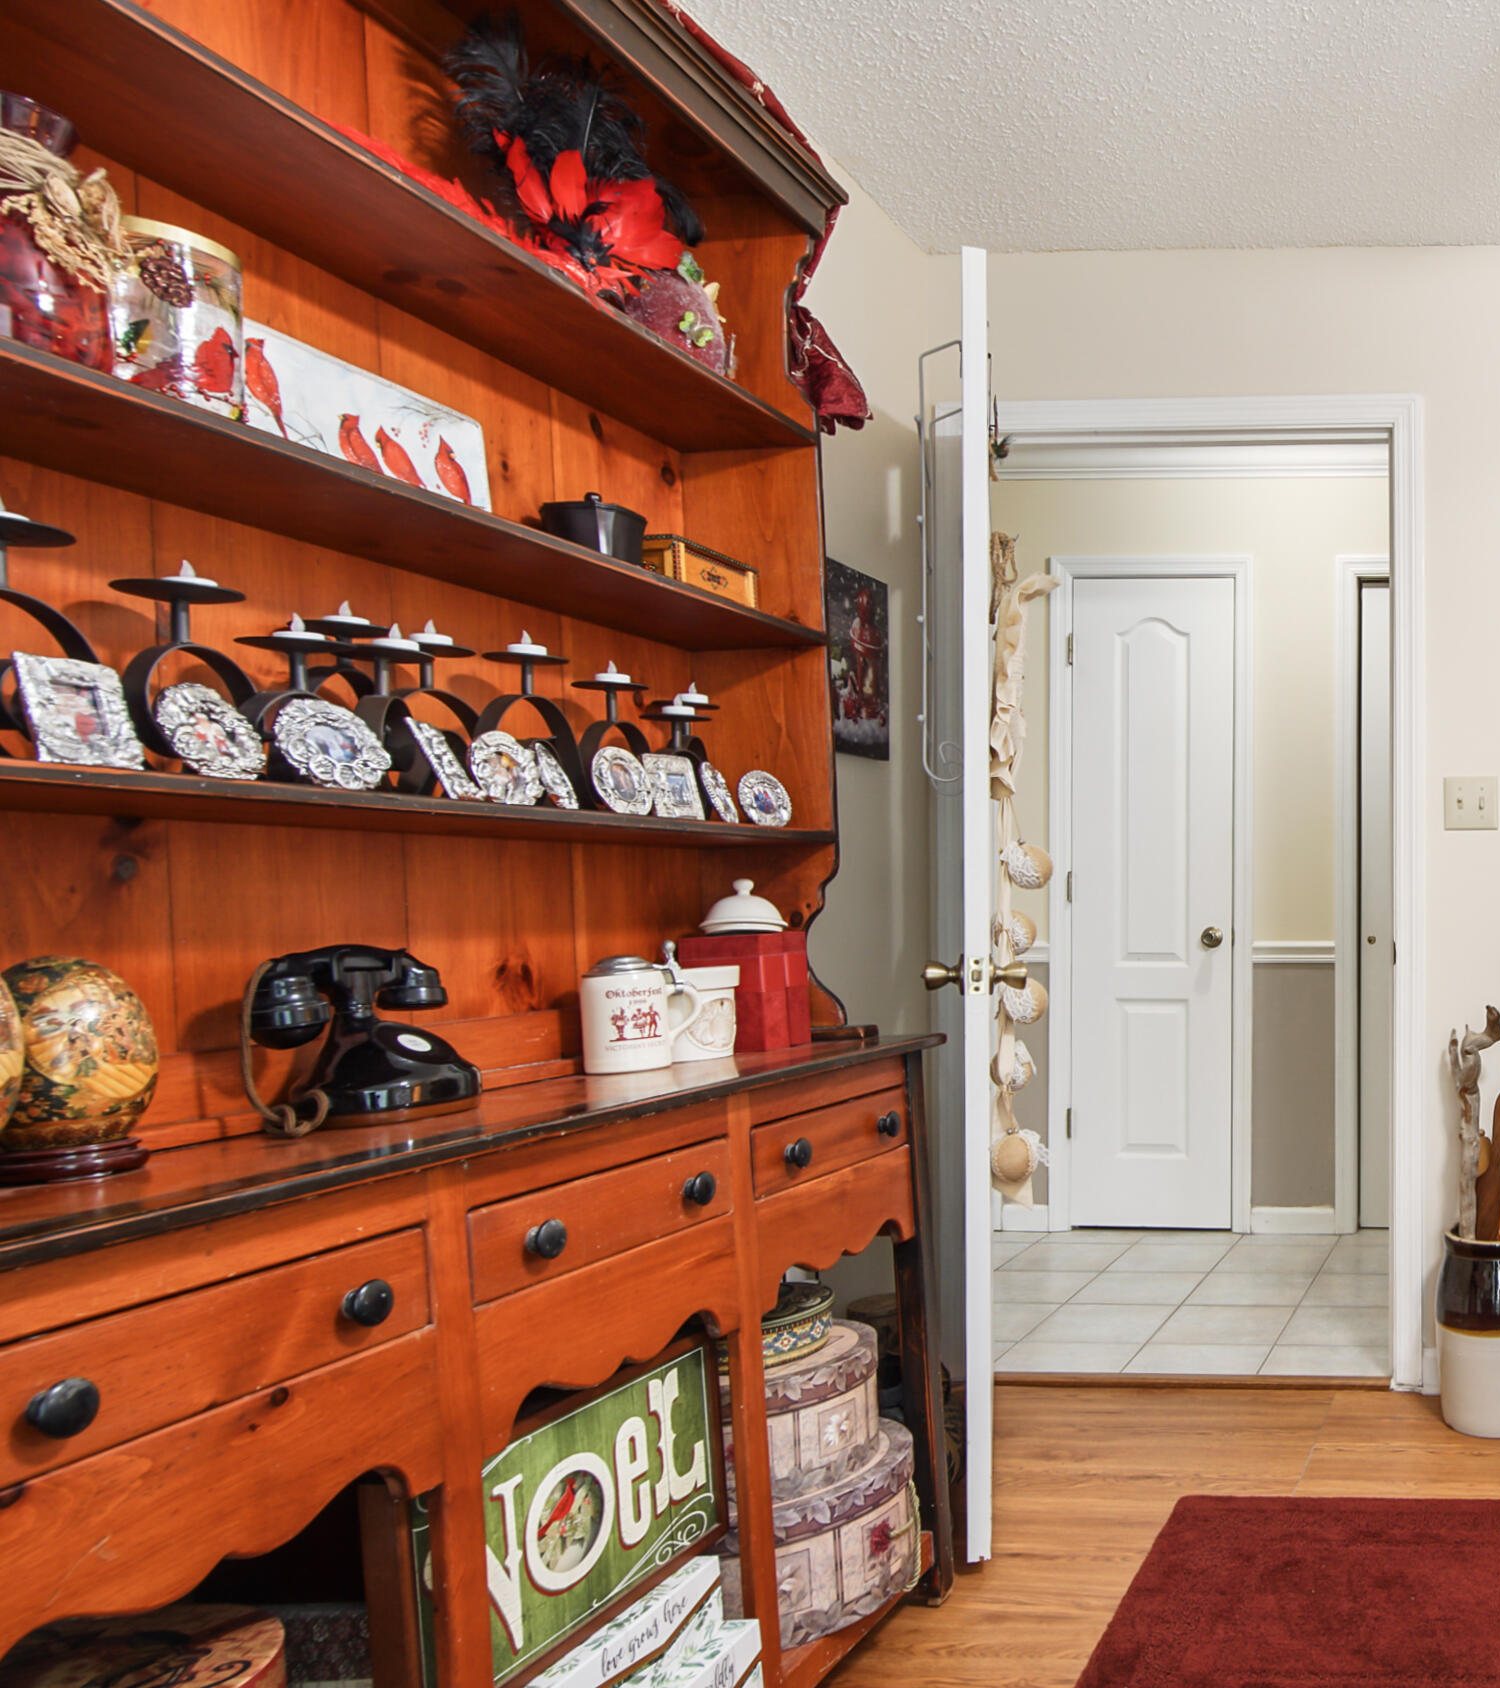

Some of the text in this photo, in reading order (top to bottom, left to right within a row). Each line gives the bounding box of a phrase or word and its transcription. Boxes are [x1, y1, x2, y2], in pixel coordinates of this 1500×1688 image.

[605, 987, 662, 999] Oktoberfest
[601, 1596, 688, 1677] love grows here
[705, 1654, 735, 1688] ildly
